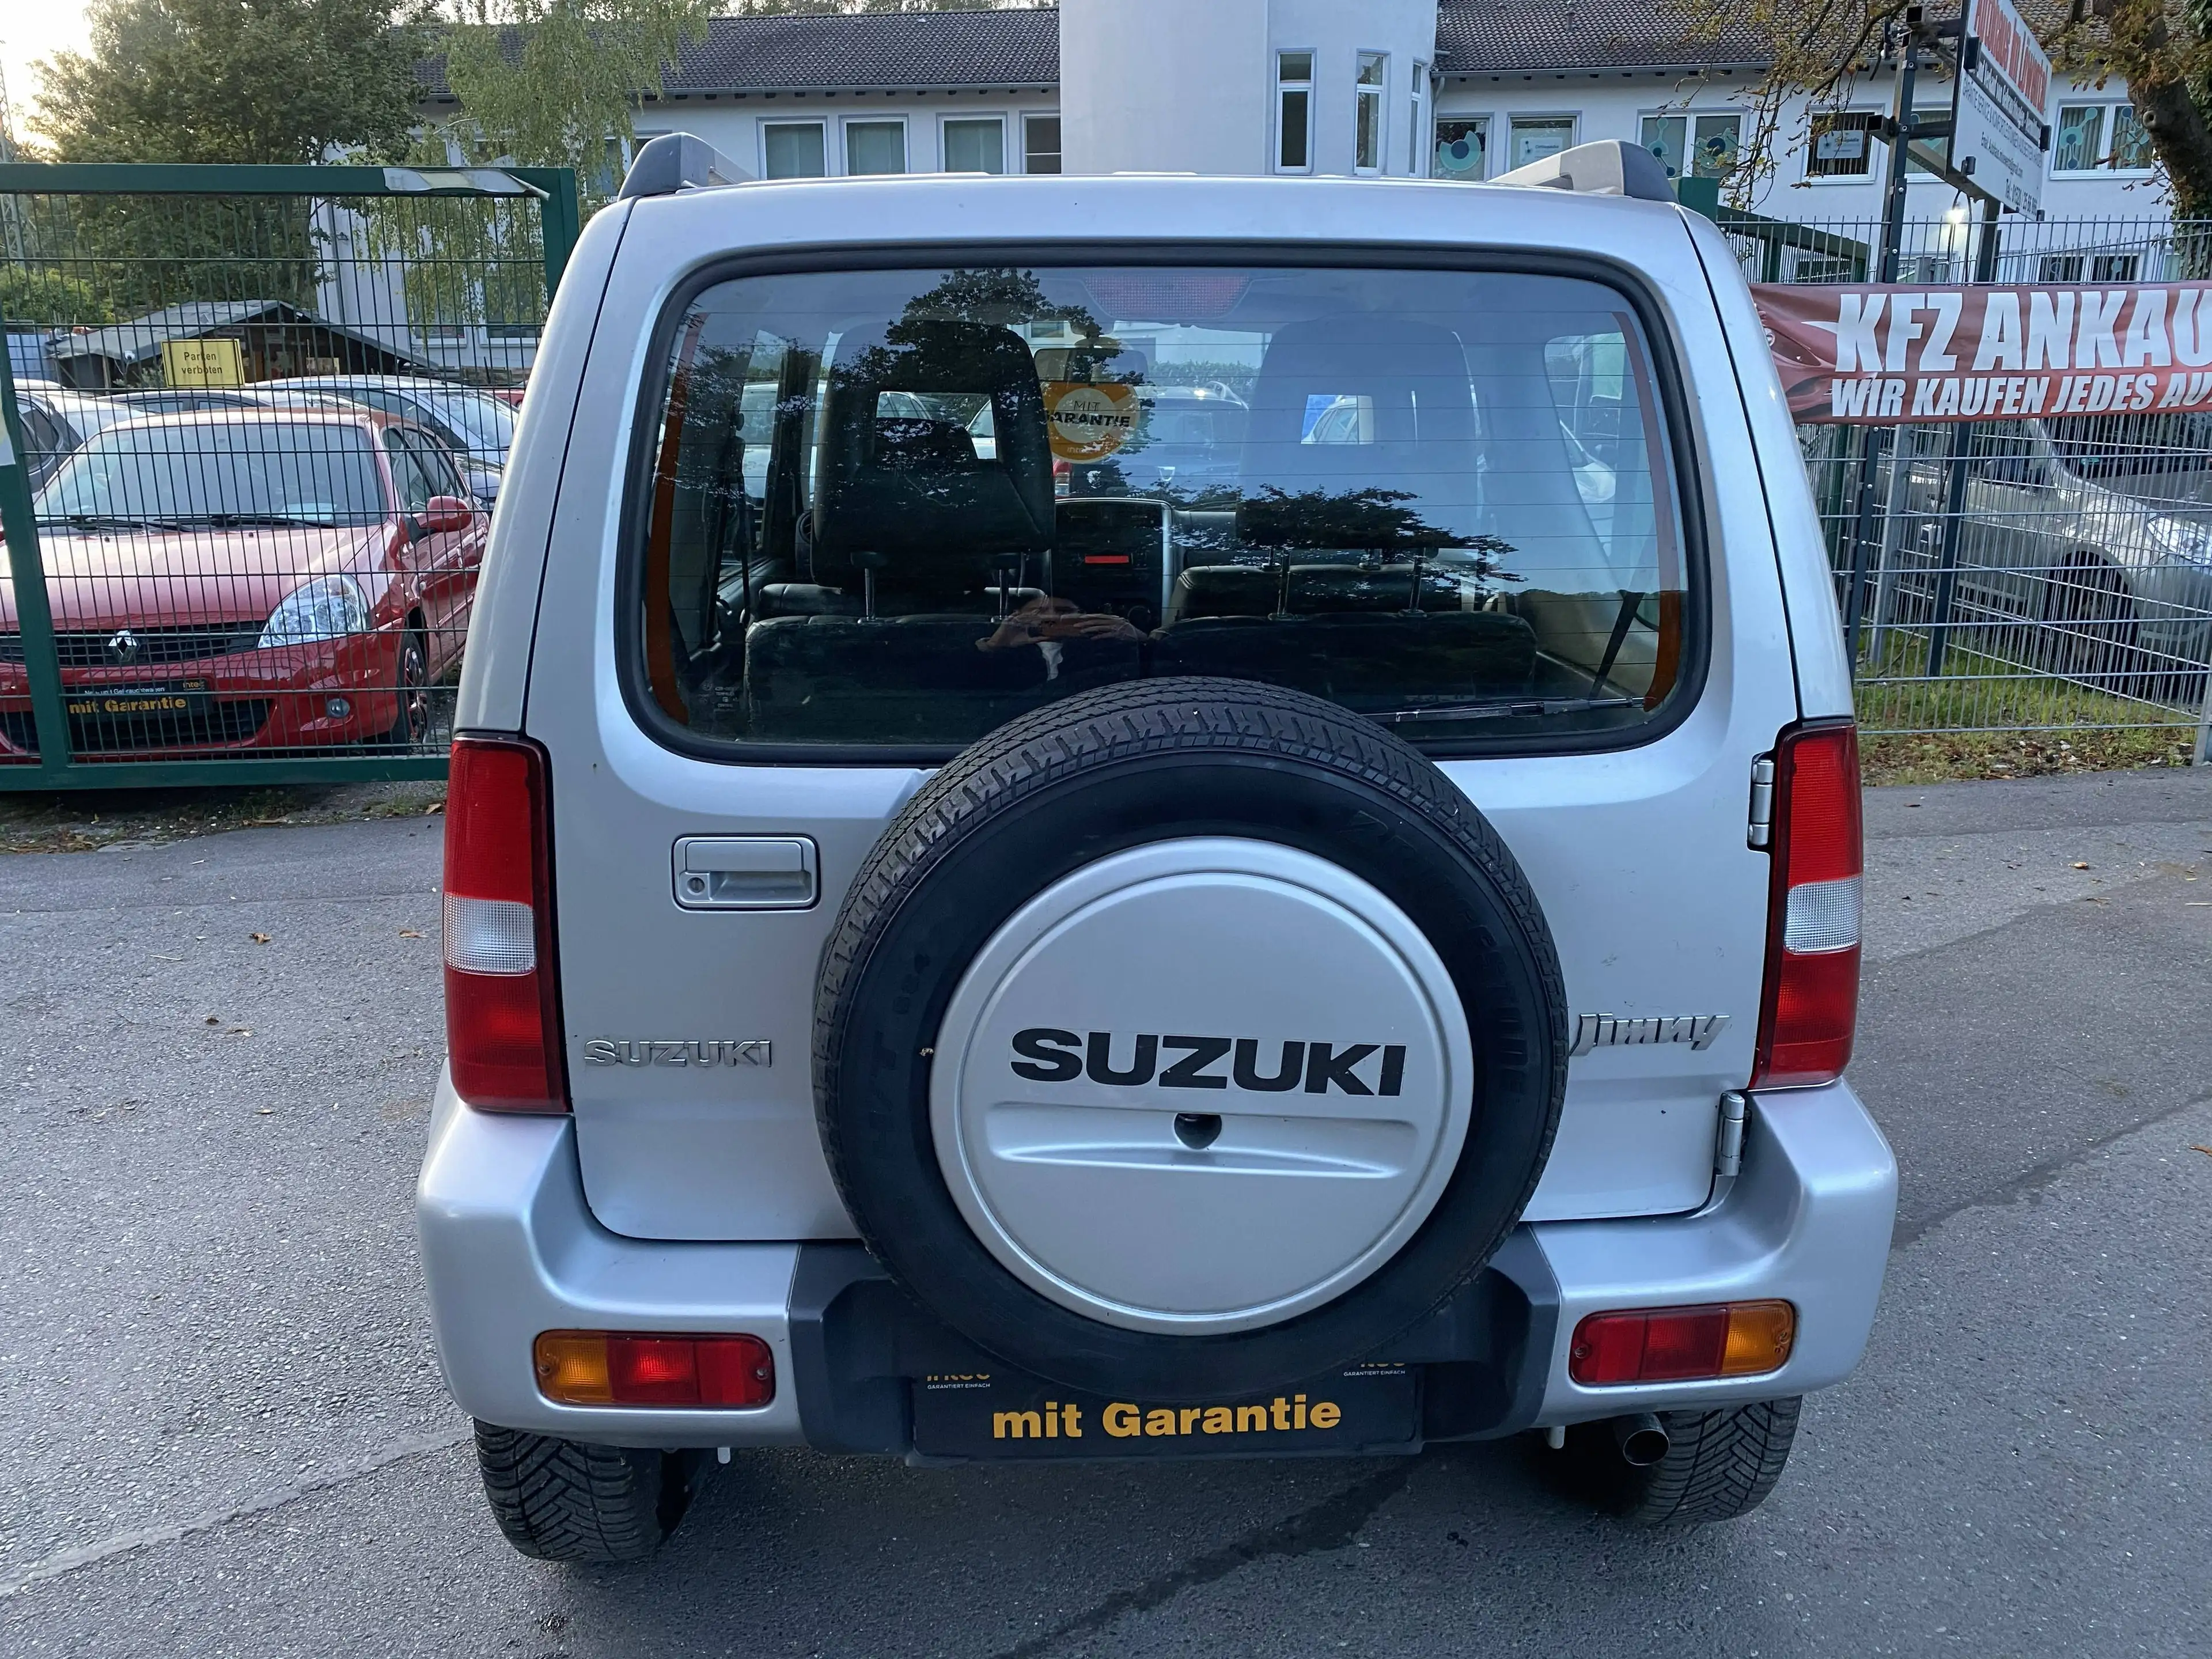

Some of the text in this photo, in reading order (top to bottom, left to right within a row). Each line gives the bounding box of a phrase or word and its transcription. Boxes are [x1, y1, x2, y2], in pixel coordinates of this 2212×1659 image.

[1835, 289, 2212, 372] KFZ ANKAU
[184, 352, 216, 361] Paren
[1832, 372, 2212, 416] WIR KAUFEN JEDES AU
[1048, 411, 1130, 427] ARANTIE
[69, 696, 187, 714] mit Garantie
[584, 1039, 771, 1067] SUZUKI
[1567, 1013, 1730, 1056] Jimny
[1010, 1028, 1407, 1096] SUZUKI
[993, 1394, 1341, 1439] mit Garantie
